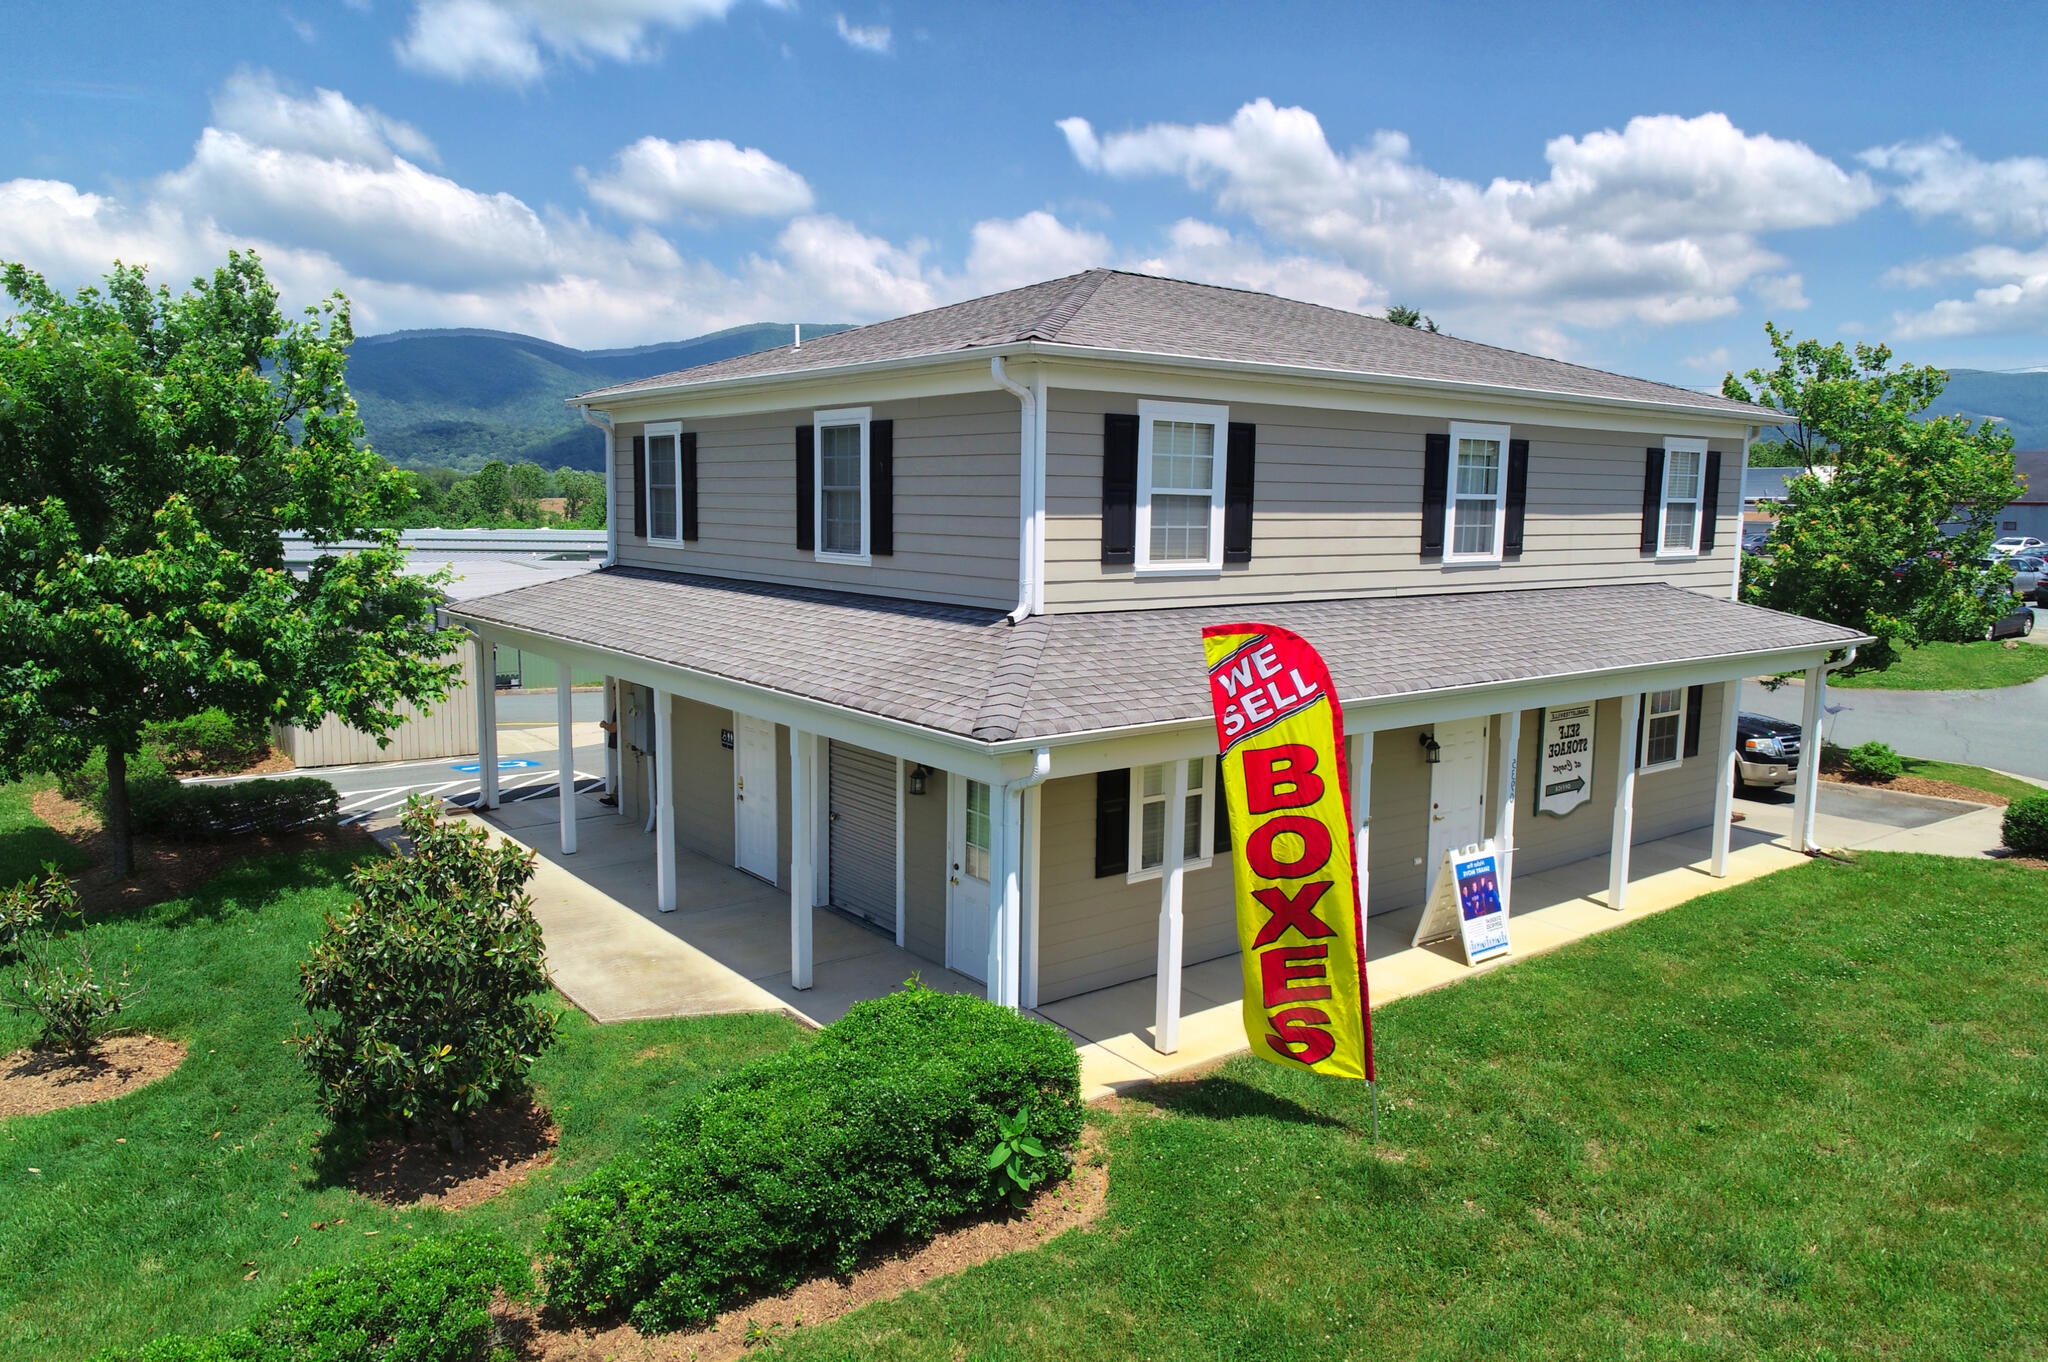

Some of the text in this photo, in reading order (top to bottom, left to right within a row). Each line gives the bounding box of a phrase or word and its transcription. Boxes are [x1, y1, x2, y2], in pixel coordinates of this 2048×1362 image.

[1217, 642, 1283, 698] WE
[1223, 668, 1318, 736] SELL
[1242, 744, 1338, 1066] BOXES
